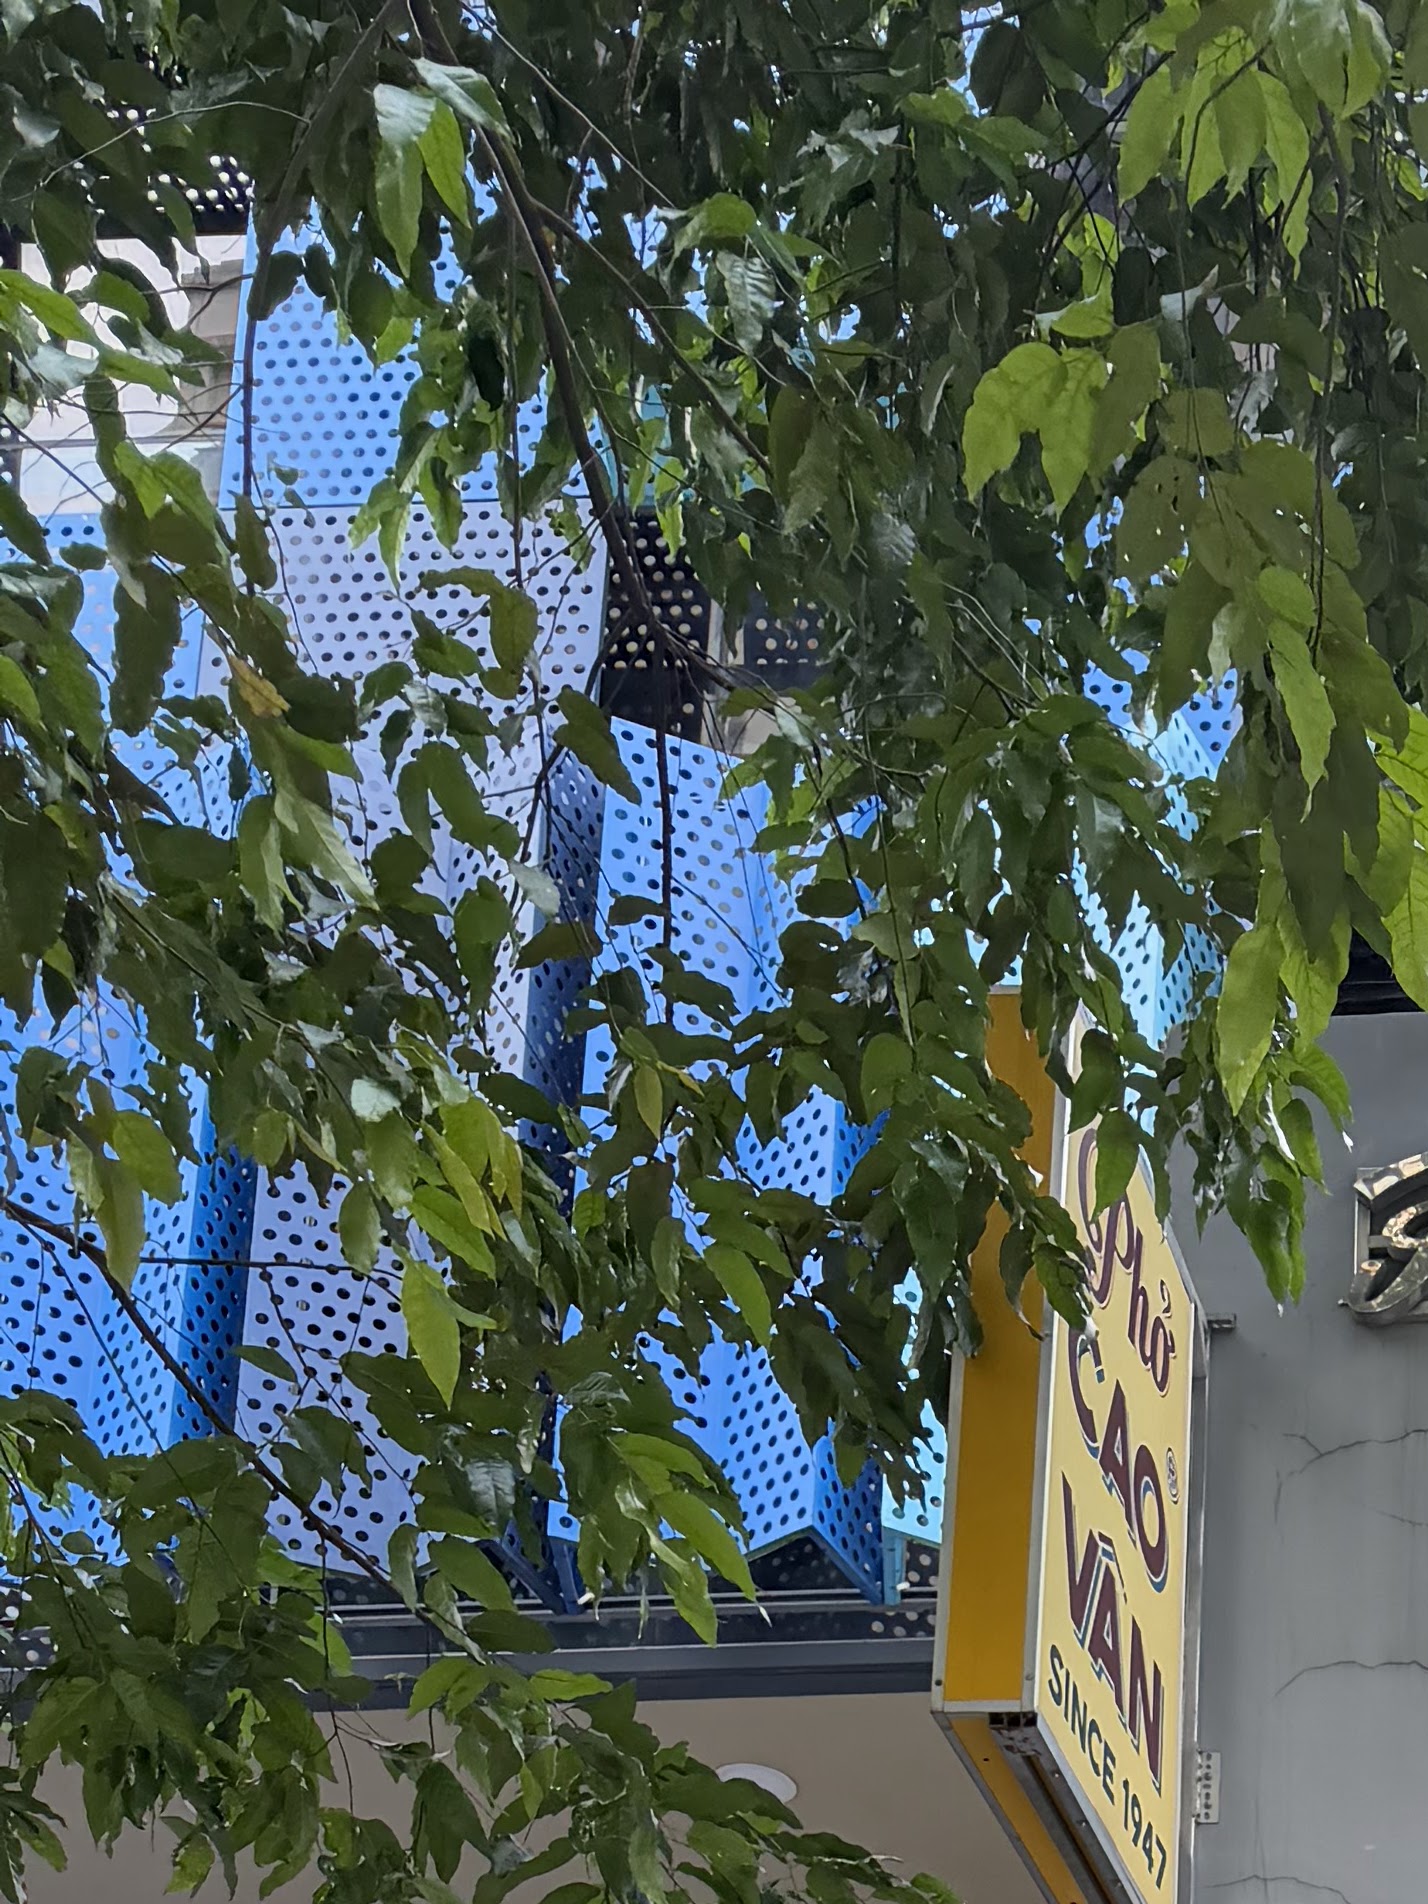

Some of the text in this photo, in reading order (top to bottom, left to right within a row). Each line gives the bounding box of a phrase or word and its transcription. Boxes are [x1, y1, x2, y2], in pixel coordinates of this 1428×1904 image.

[1048, 1644, 1168, 1890] SINCE 1947
[1060, 1470, 1164, 1798] VÂN
